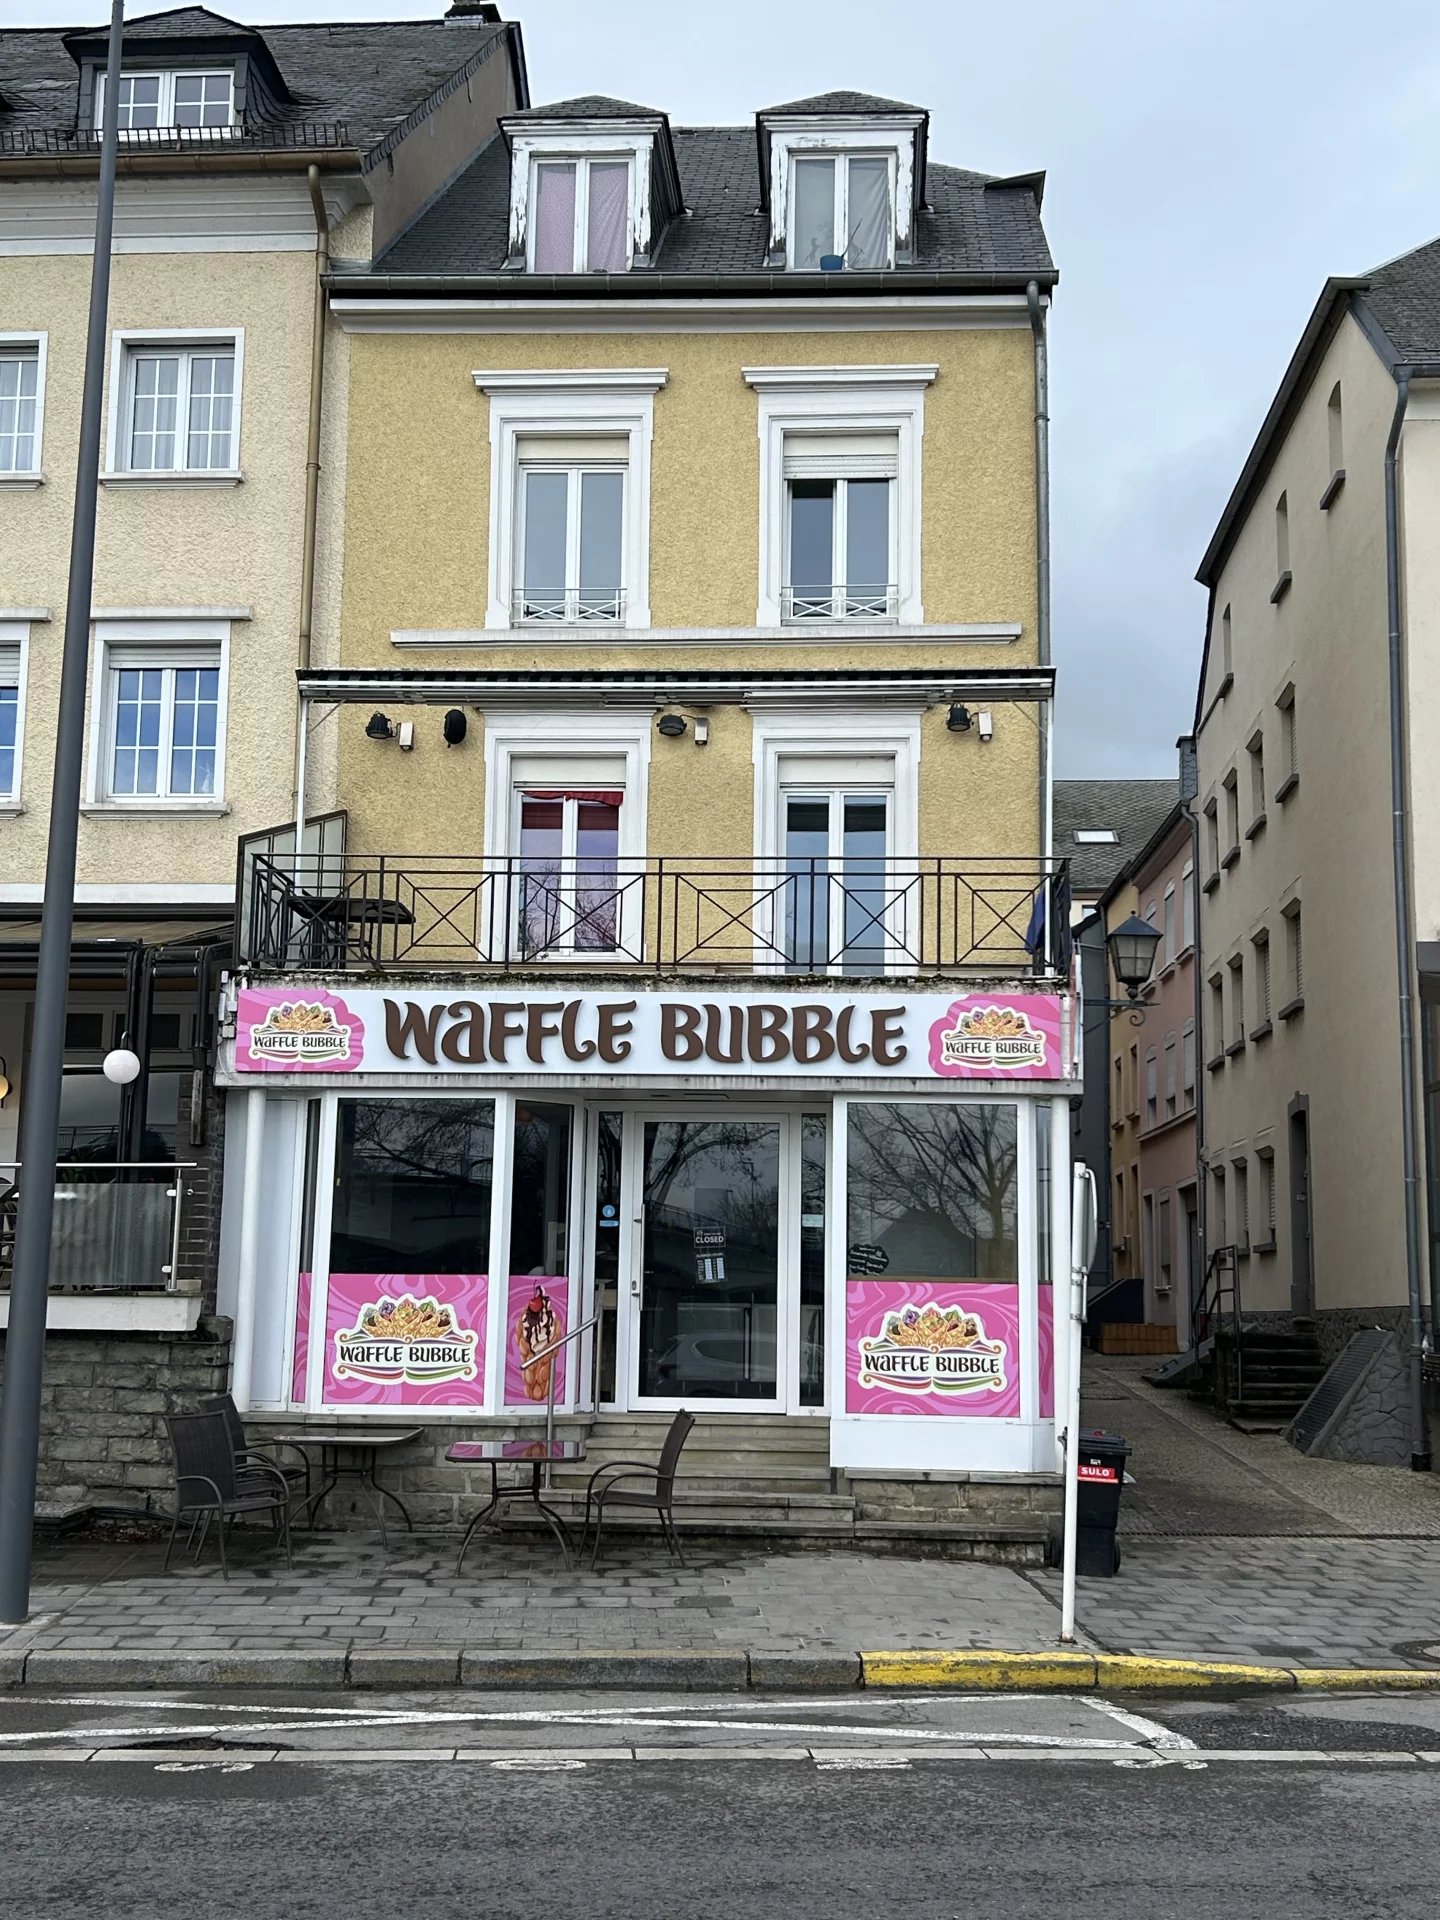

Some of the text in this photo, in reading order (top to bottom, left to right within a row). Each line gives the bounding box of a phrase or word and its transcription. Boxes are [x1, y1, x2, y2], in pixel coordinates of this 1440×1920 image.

[302, 1036, 346, 1048] BUBBLE
[660, 1003, 908, 1067] BUBBLE
[996, 1041, 1040, 1055] BUBBLE
[695, 1236, 724, 1244] CLOSED
[410, 1346, 471, 1363] BUBBLE
[936, 1355, 999, 1374] BUBBLE
[1081, 1466, 1110, 1476] SULO
